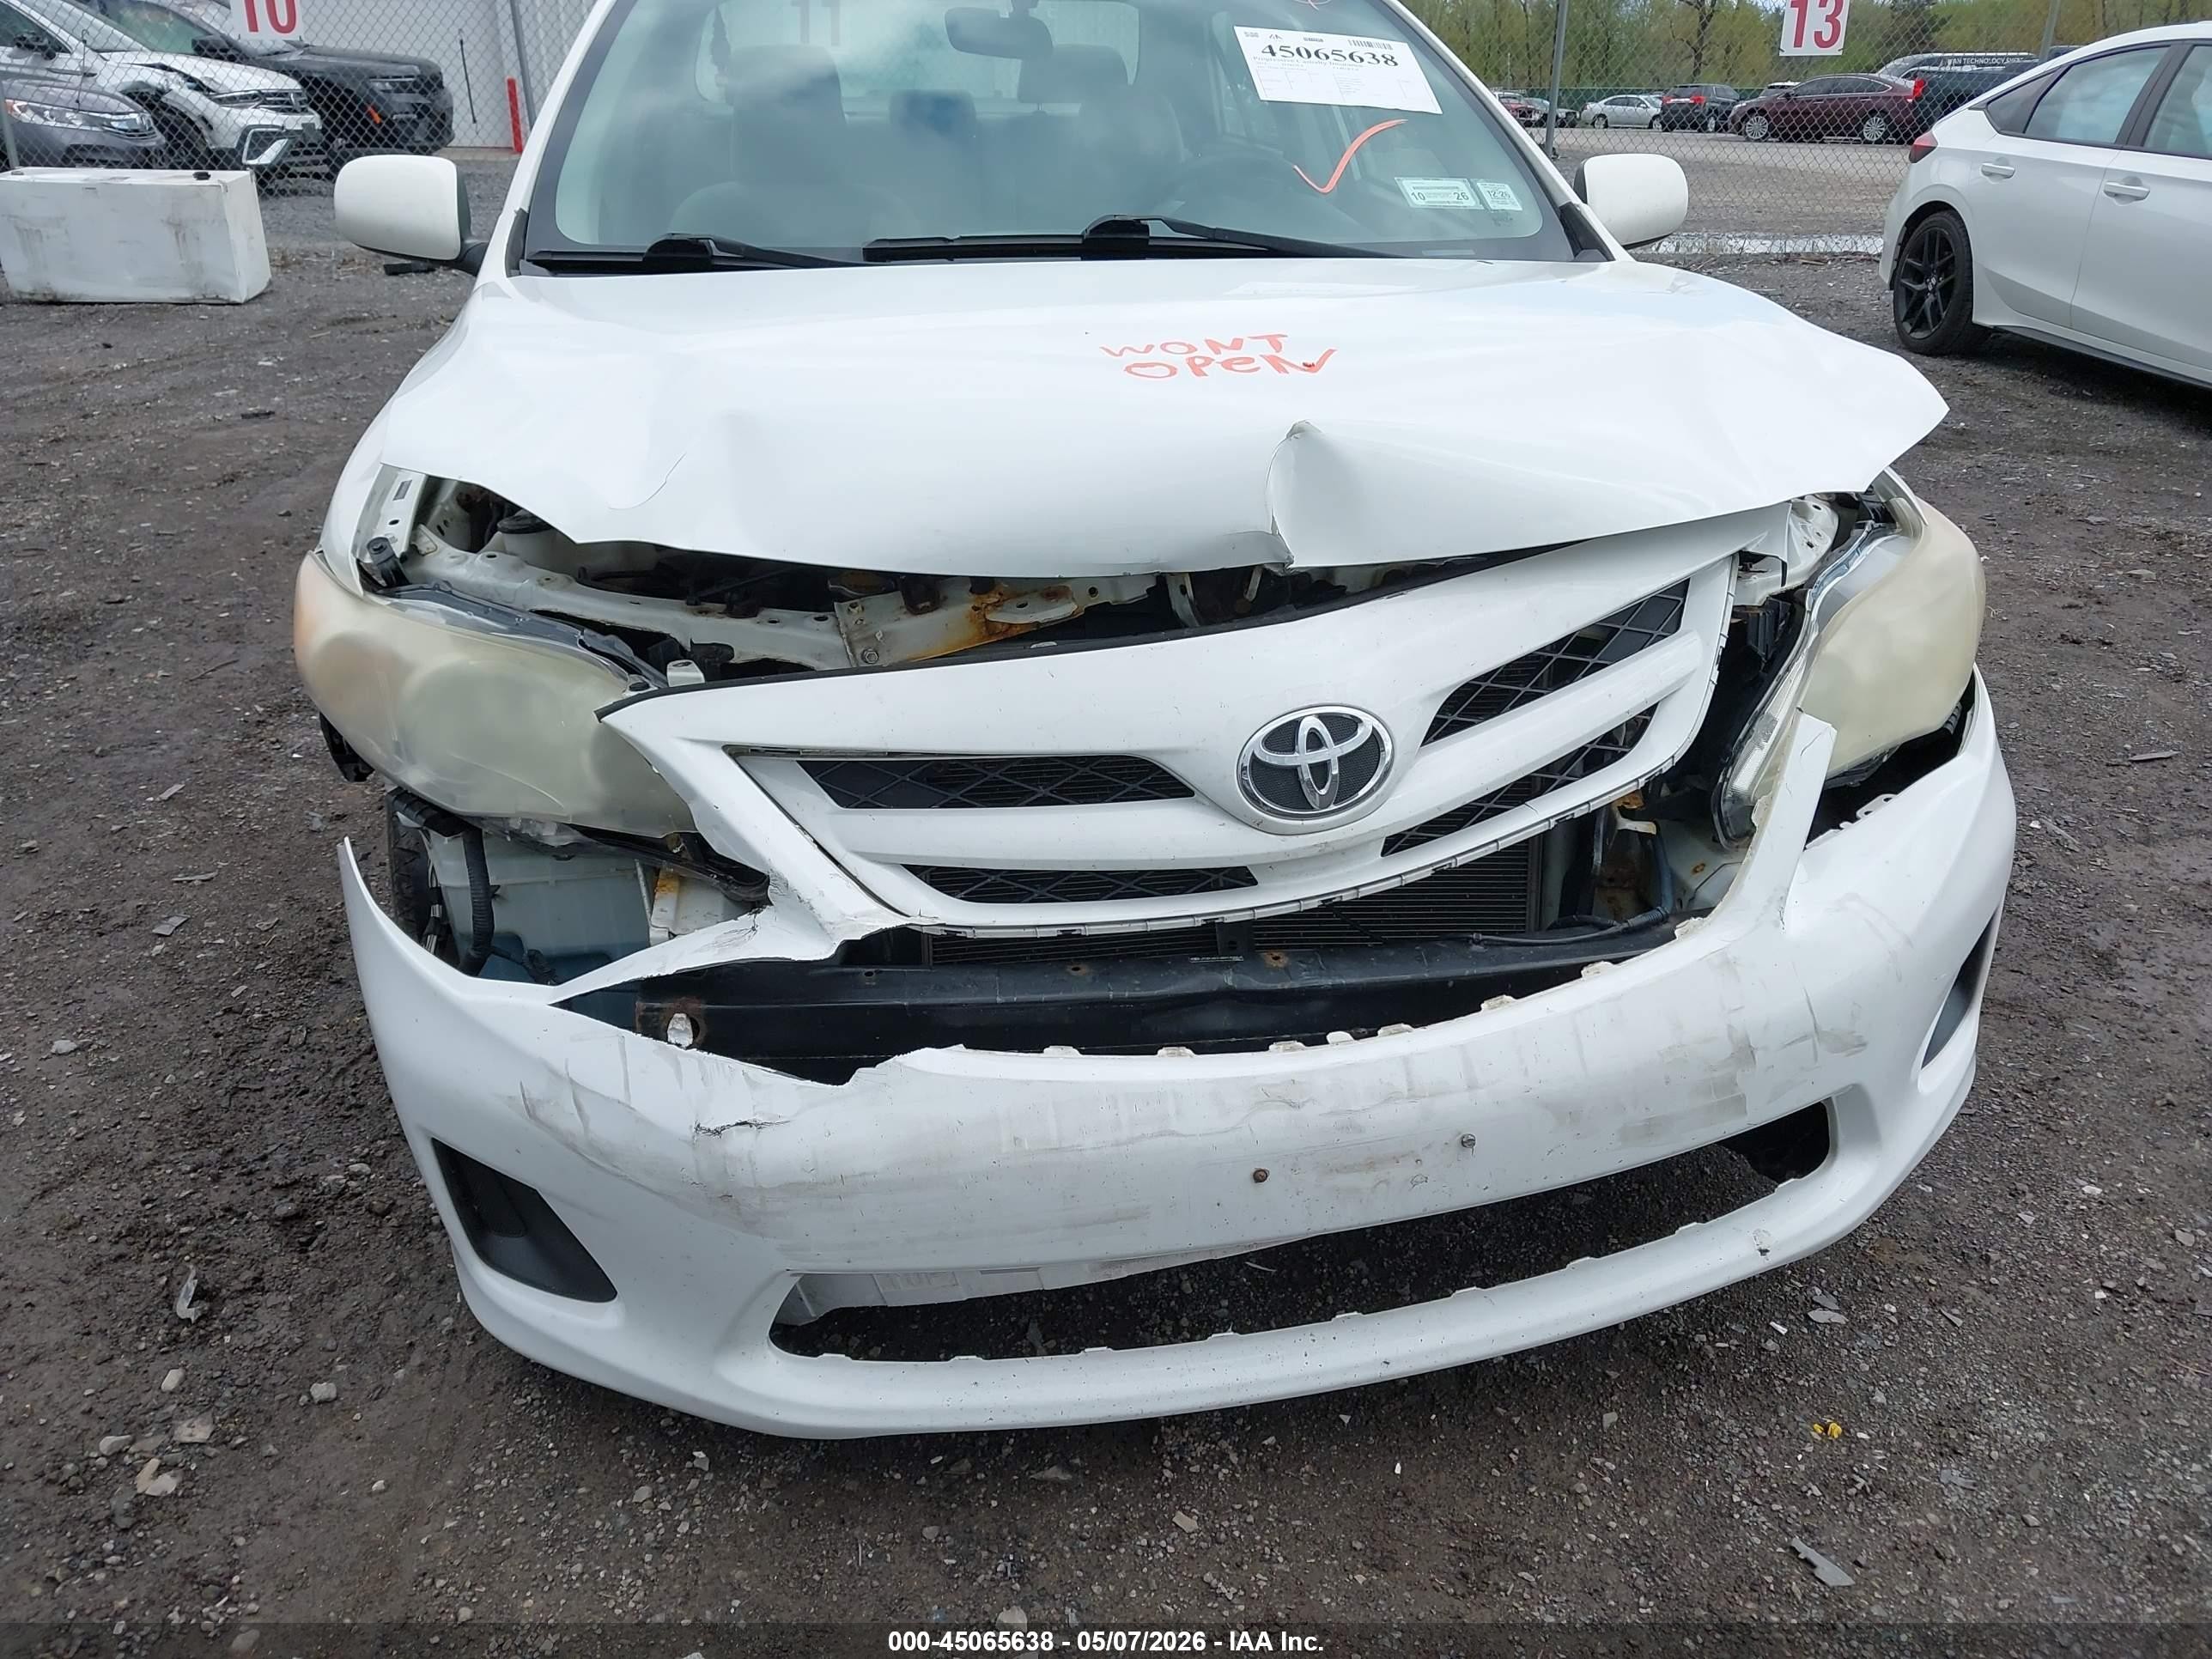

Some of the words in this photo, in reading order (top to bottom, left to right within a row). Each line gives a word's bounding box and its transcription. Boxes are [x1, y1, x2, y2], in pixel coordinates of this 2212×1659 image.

[244, 0, 297, 33] 10
[1790, 0, 1844, 48] 13
[1261, 44, 1399, 67] 45065638
[1099, 333, 1288, 356] WONT
